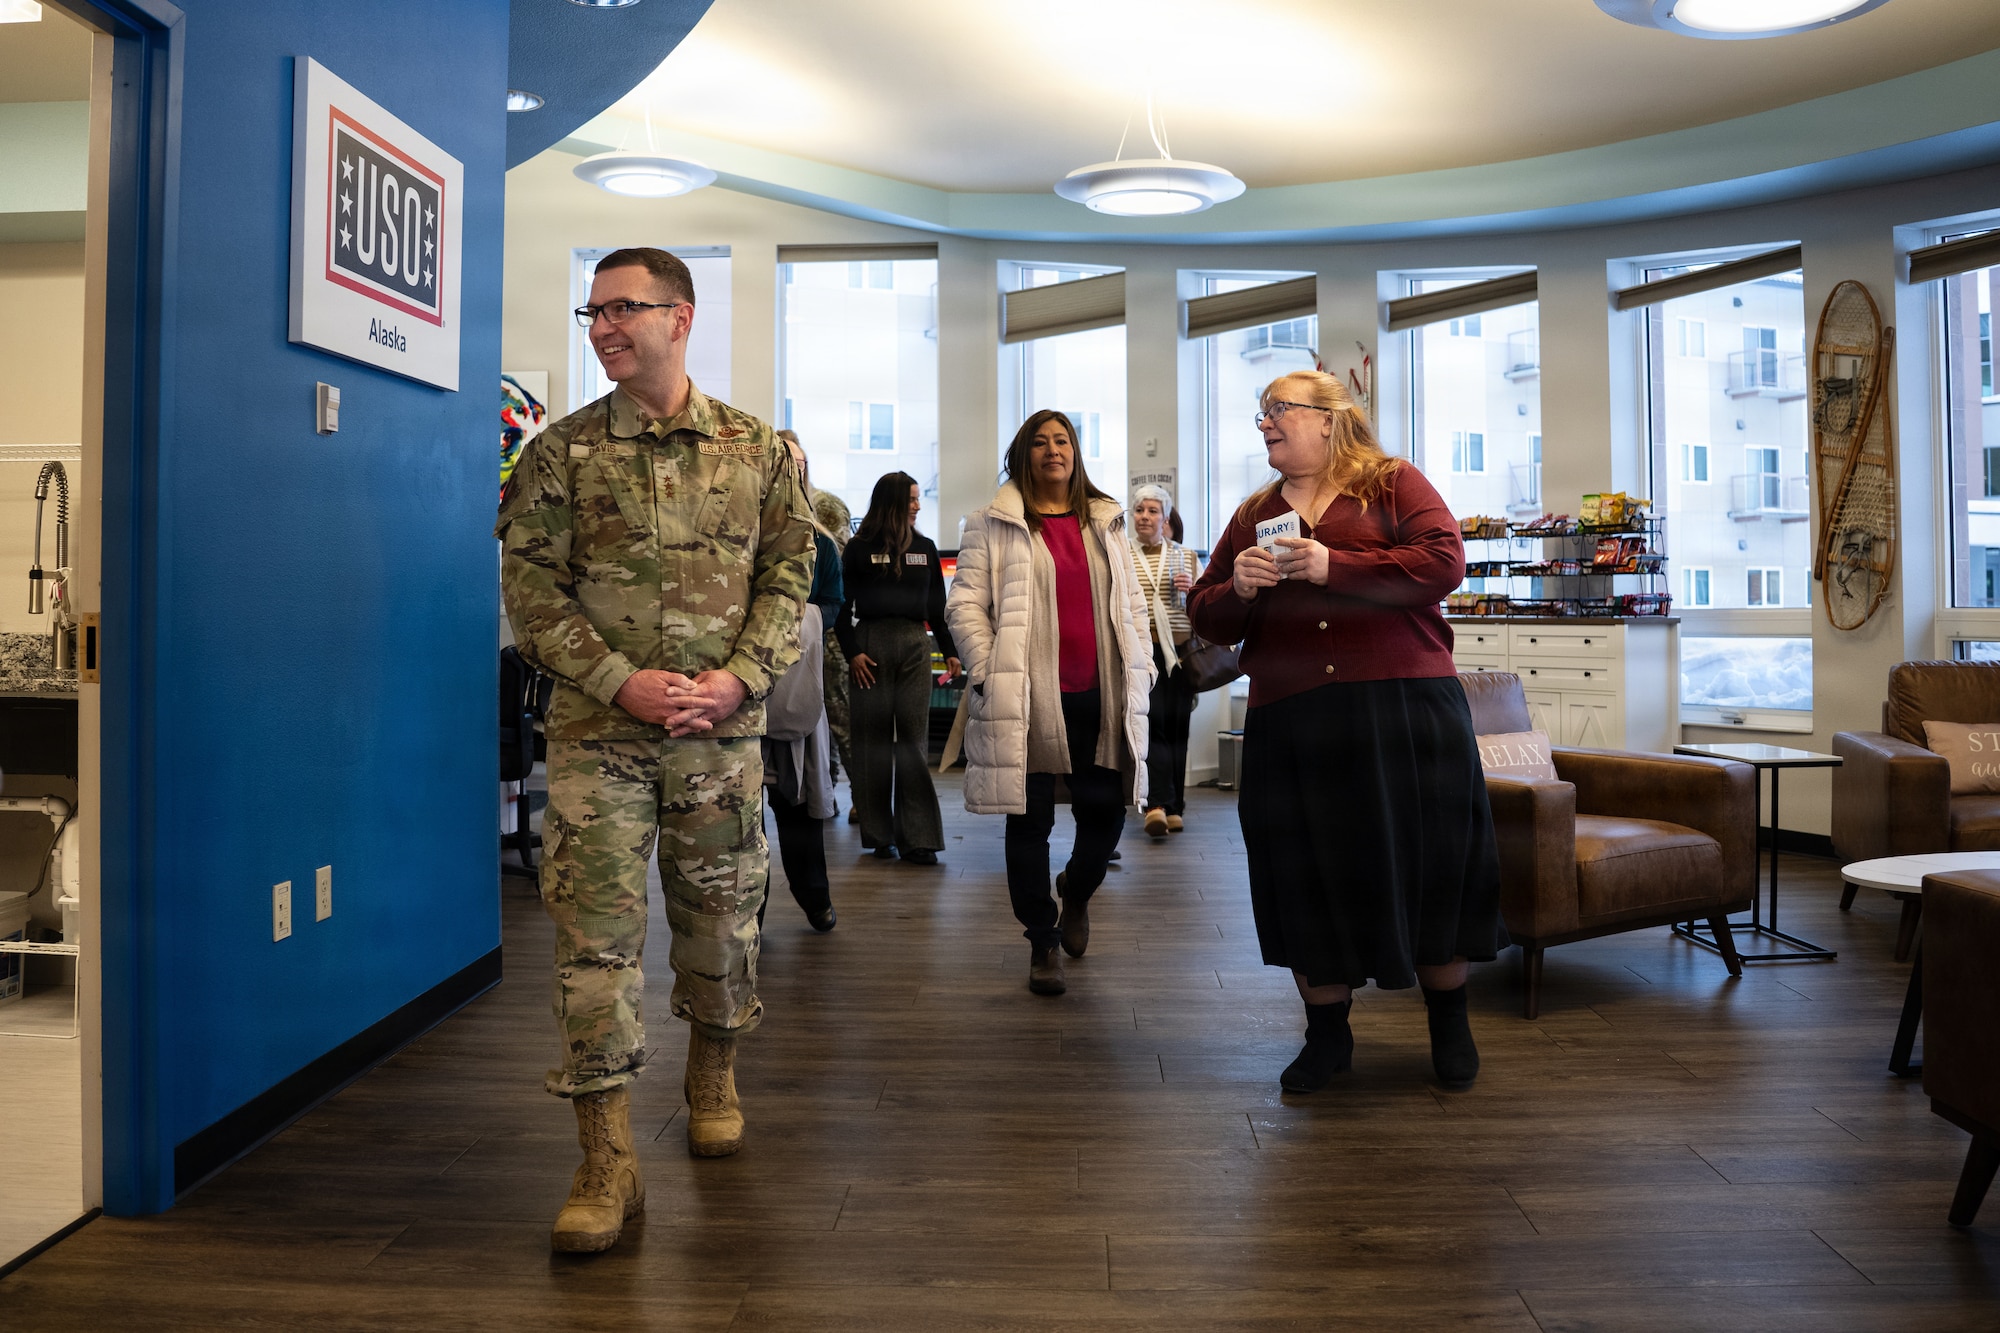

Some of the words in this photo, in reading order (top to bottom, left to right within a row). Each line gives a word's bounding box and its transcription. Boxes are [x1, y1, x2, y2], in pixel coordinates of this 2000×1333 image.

[356, 155, 422, 287] USO
[368, 317, 407, 353] Alaska
[588, 443, 617, 457] DAVIS
[700, 443, 714, 454] U.S.
[717, 444, 734, 455] AIR
[734, 444, 762, 455] FORCE
[1131, 475, 1147, 486] COFFEE
[1148, 474, 1156, 483] TEA
[1477, 743, 1549, 769] RELAX
